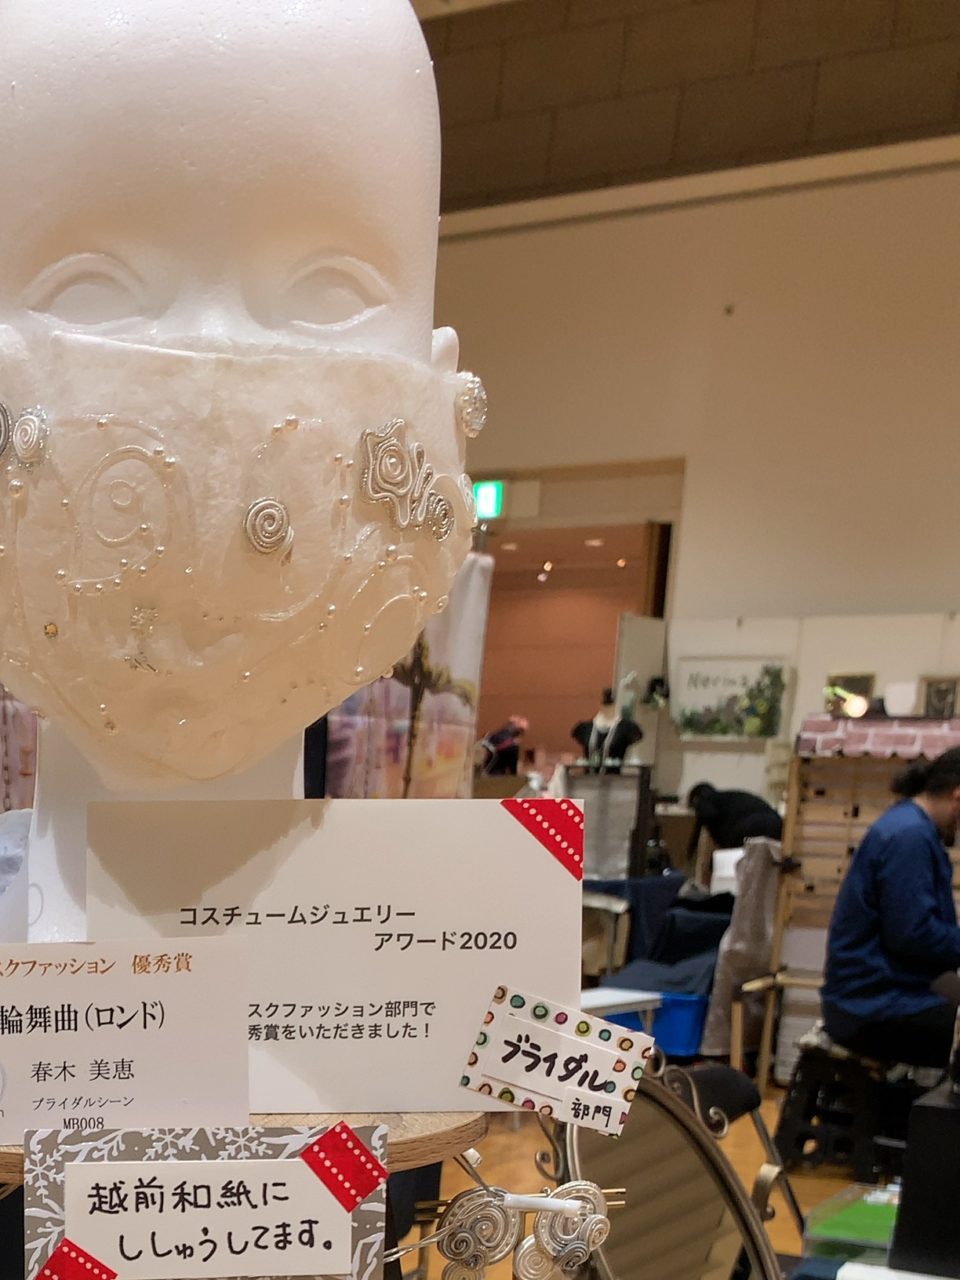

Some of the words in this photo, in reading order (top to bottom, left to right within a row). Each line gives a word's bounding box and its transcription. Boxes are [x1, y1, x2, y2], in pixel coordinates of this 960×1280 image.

[179, 904, 416, 927] コスチュームジュエリー
[374, 931, 518, 952] アワード2020
[131, 952, 193, 976] 優秀賞
[247, 1000, 437, 1020] スクファッション部門で
[247, 1023, 431, 1042] 秀賞をいただきました！
[30, 1060, 76, 1083] 春木
[89, 1058, 135, 1081] 美恵
[501, 1033, 609, 1093] ブライダル
[32, 1095, 135, 1112] ブライダルシーン
[571, 1097, 613, 1128] 部門
[62, 1116, 105, 1130] MB008
[88, 1176, 290, 1215] 越前和紙に
[118, 1218, 333, 1263] ししゅうしてます。
